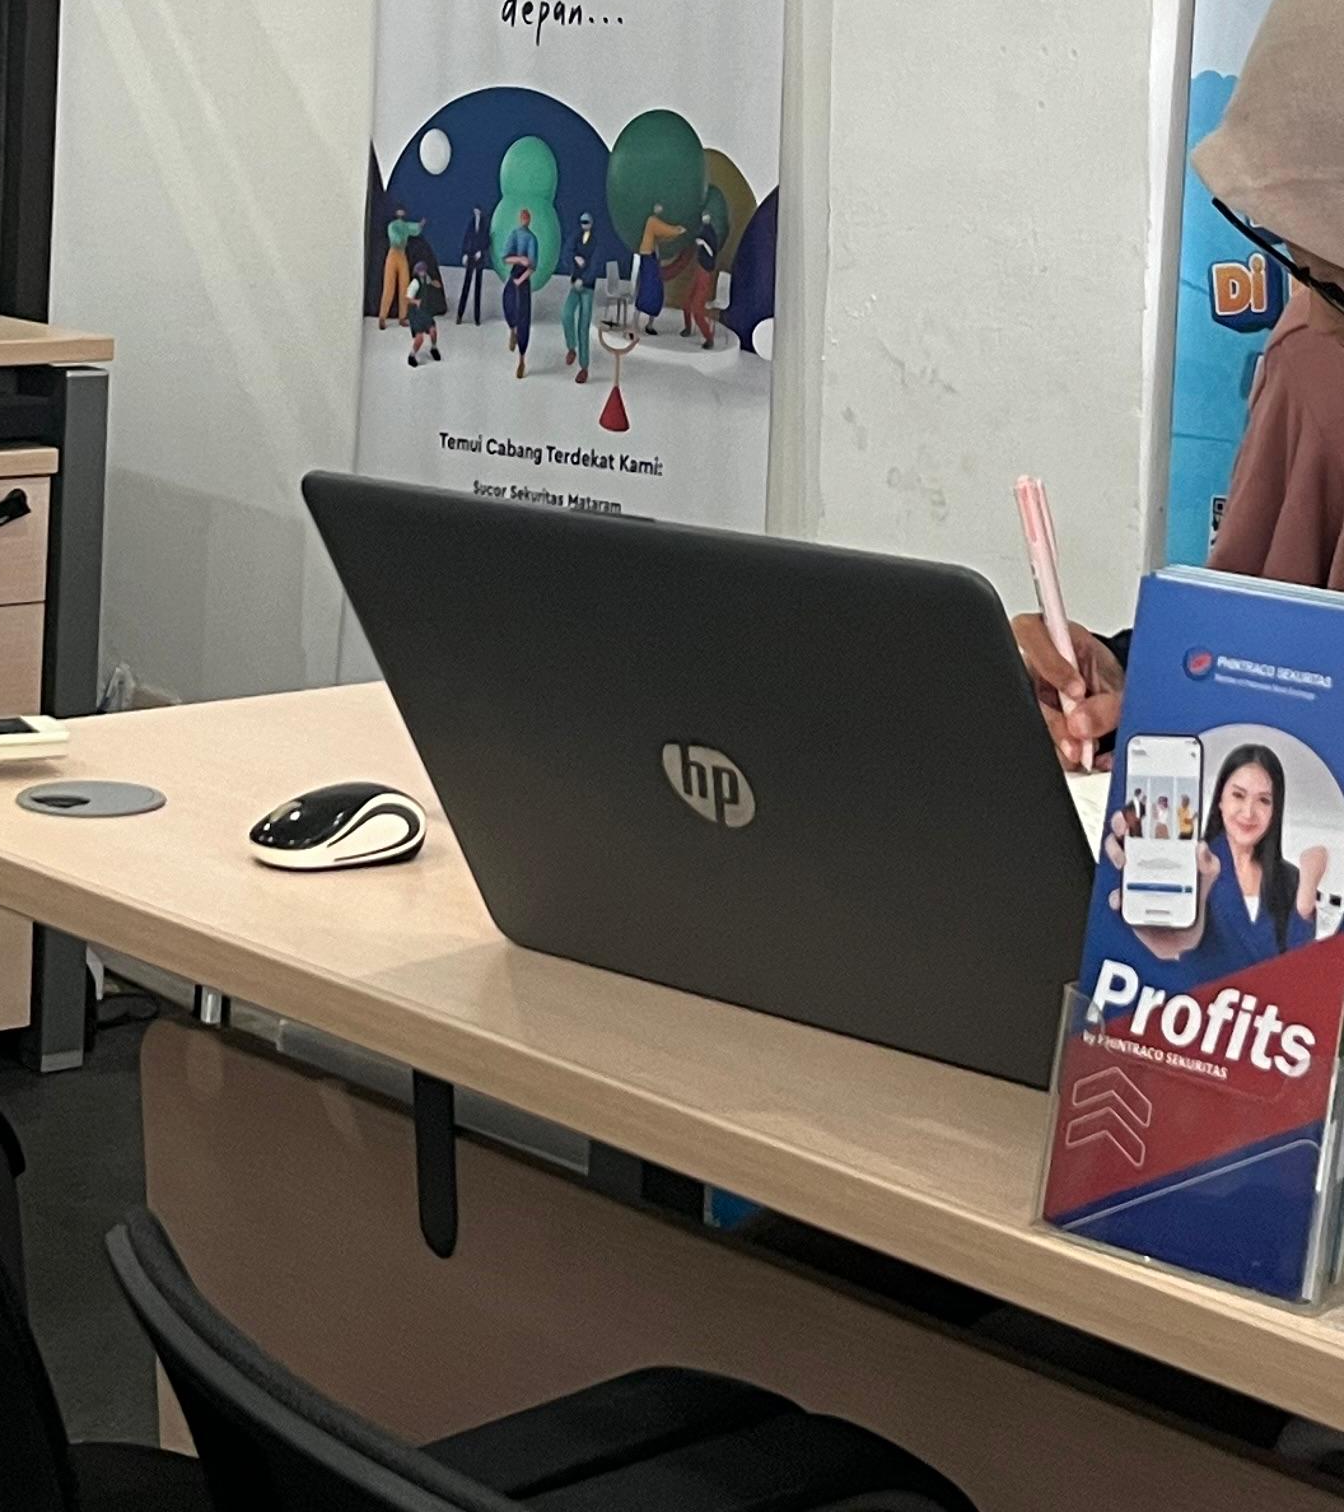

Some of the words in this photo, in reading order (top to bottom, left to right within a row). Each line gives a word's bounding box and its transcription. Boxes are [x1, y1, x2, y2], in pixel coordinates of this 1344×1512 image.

[439, 431, 483, 455] Temui
[486, 437, 543, 466] Cabang
[546, 445, 615, 471] Terdekat
[618, 455, 664, 477] Kami:
[472, 479, 507, 497] Sucor
[510, 484, 564, 506] Sekuritas
[567, 493, 622, 514] Mataram
[673, 743, 747, 827] hp
[1085, 958, 1316, 1078] Profits
[1165, 1051, 1229, 1081] SEKURITAS
